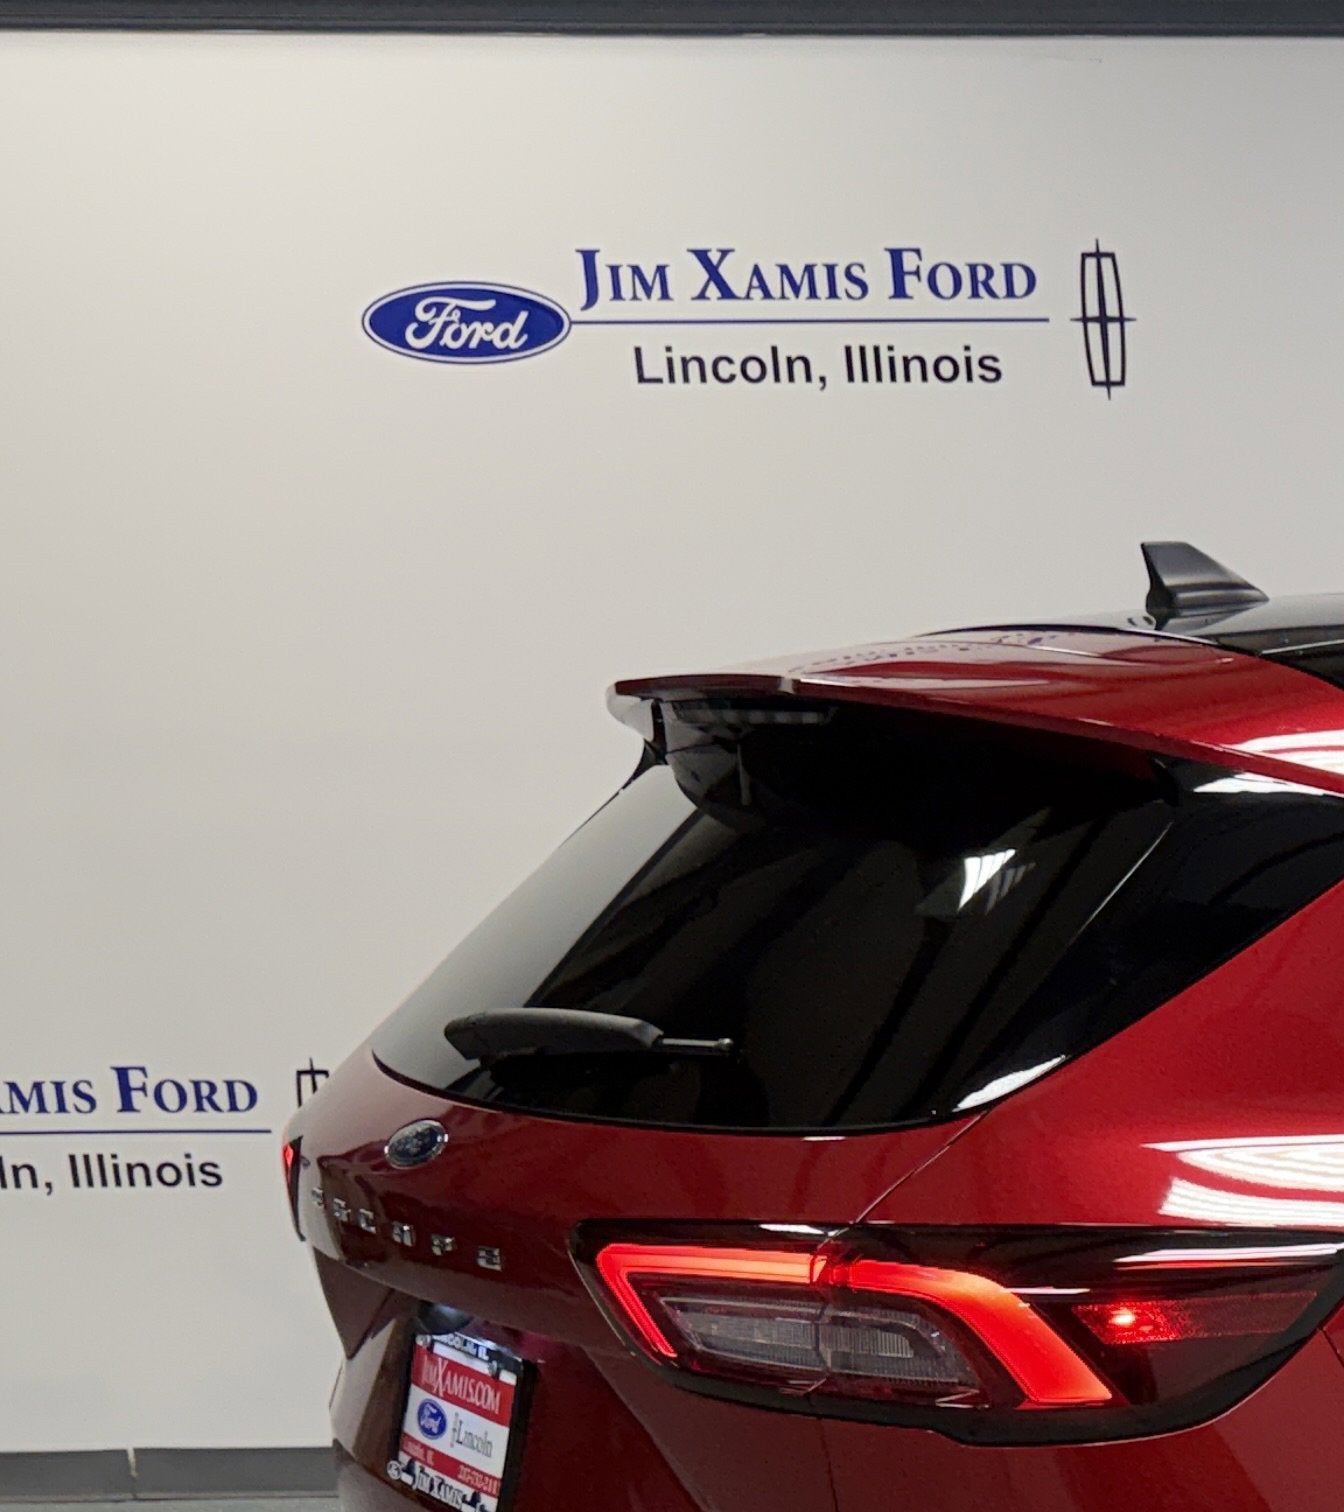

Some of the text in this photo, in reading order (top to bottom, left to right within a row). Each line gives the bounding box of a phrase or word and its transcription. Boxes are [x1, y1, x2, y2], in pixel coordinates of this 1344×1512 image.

[575, 247, 1037, 311] JIM XAMIS FORD
[405, 296, 528, 350] Ford
[634, 345, 1002, 391] Lincoln, Illinois
[110, 1066, 258, 1113] FORD
[68, 1153, 223, 1188] Illinois
